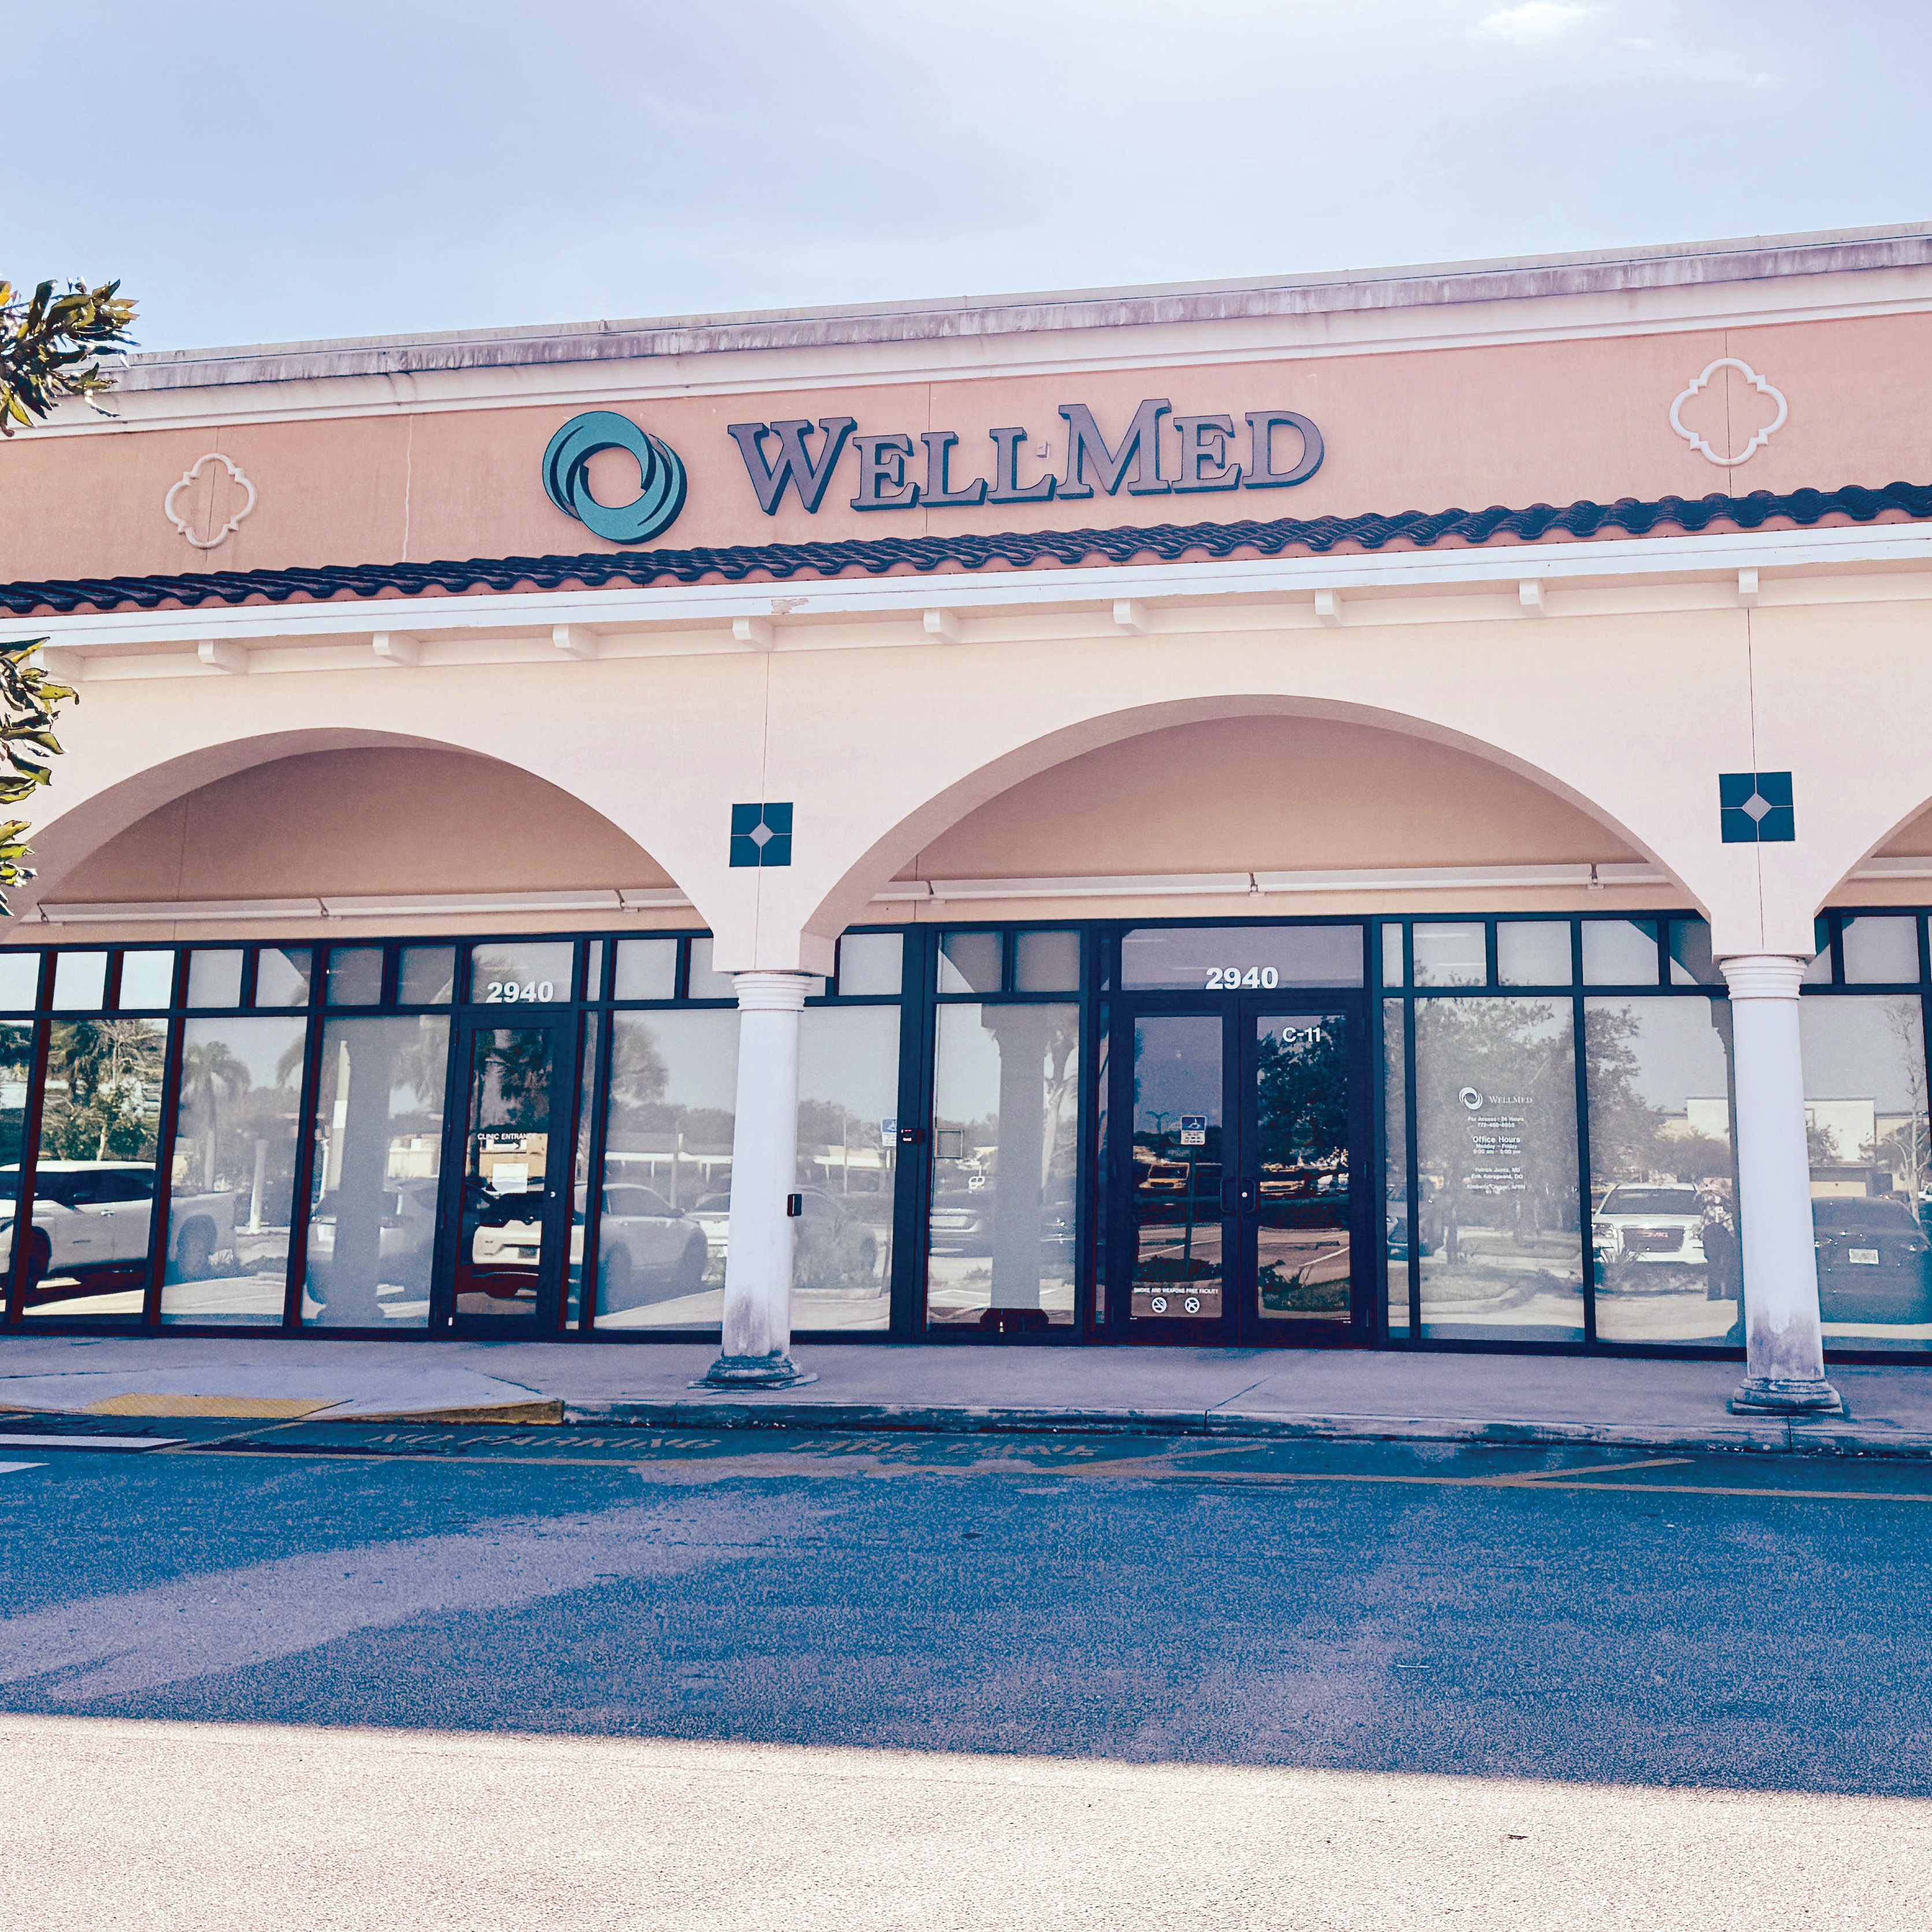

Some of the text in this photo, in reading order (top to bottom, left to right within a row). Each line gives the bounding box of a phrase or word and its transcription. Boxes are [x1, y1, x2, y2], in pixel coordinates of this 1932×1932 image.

[1205, 966, 1278, 989] 2940
[485, 981, 554, 1003] 2940
[1282, 1027, 1321, 1043] C-11
[457, 1434, 722, 1449] PARKING
